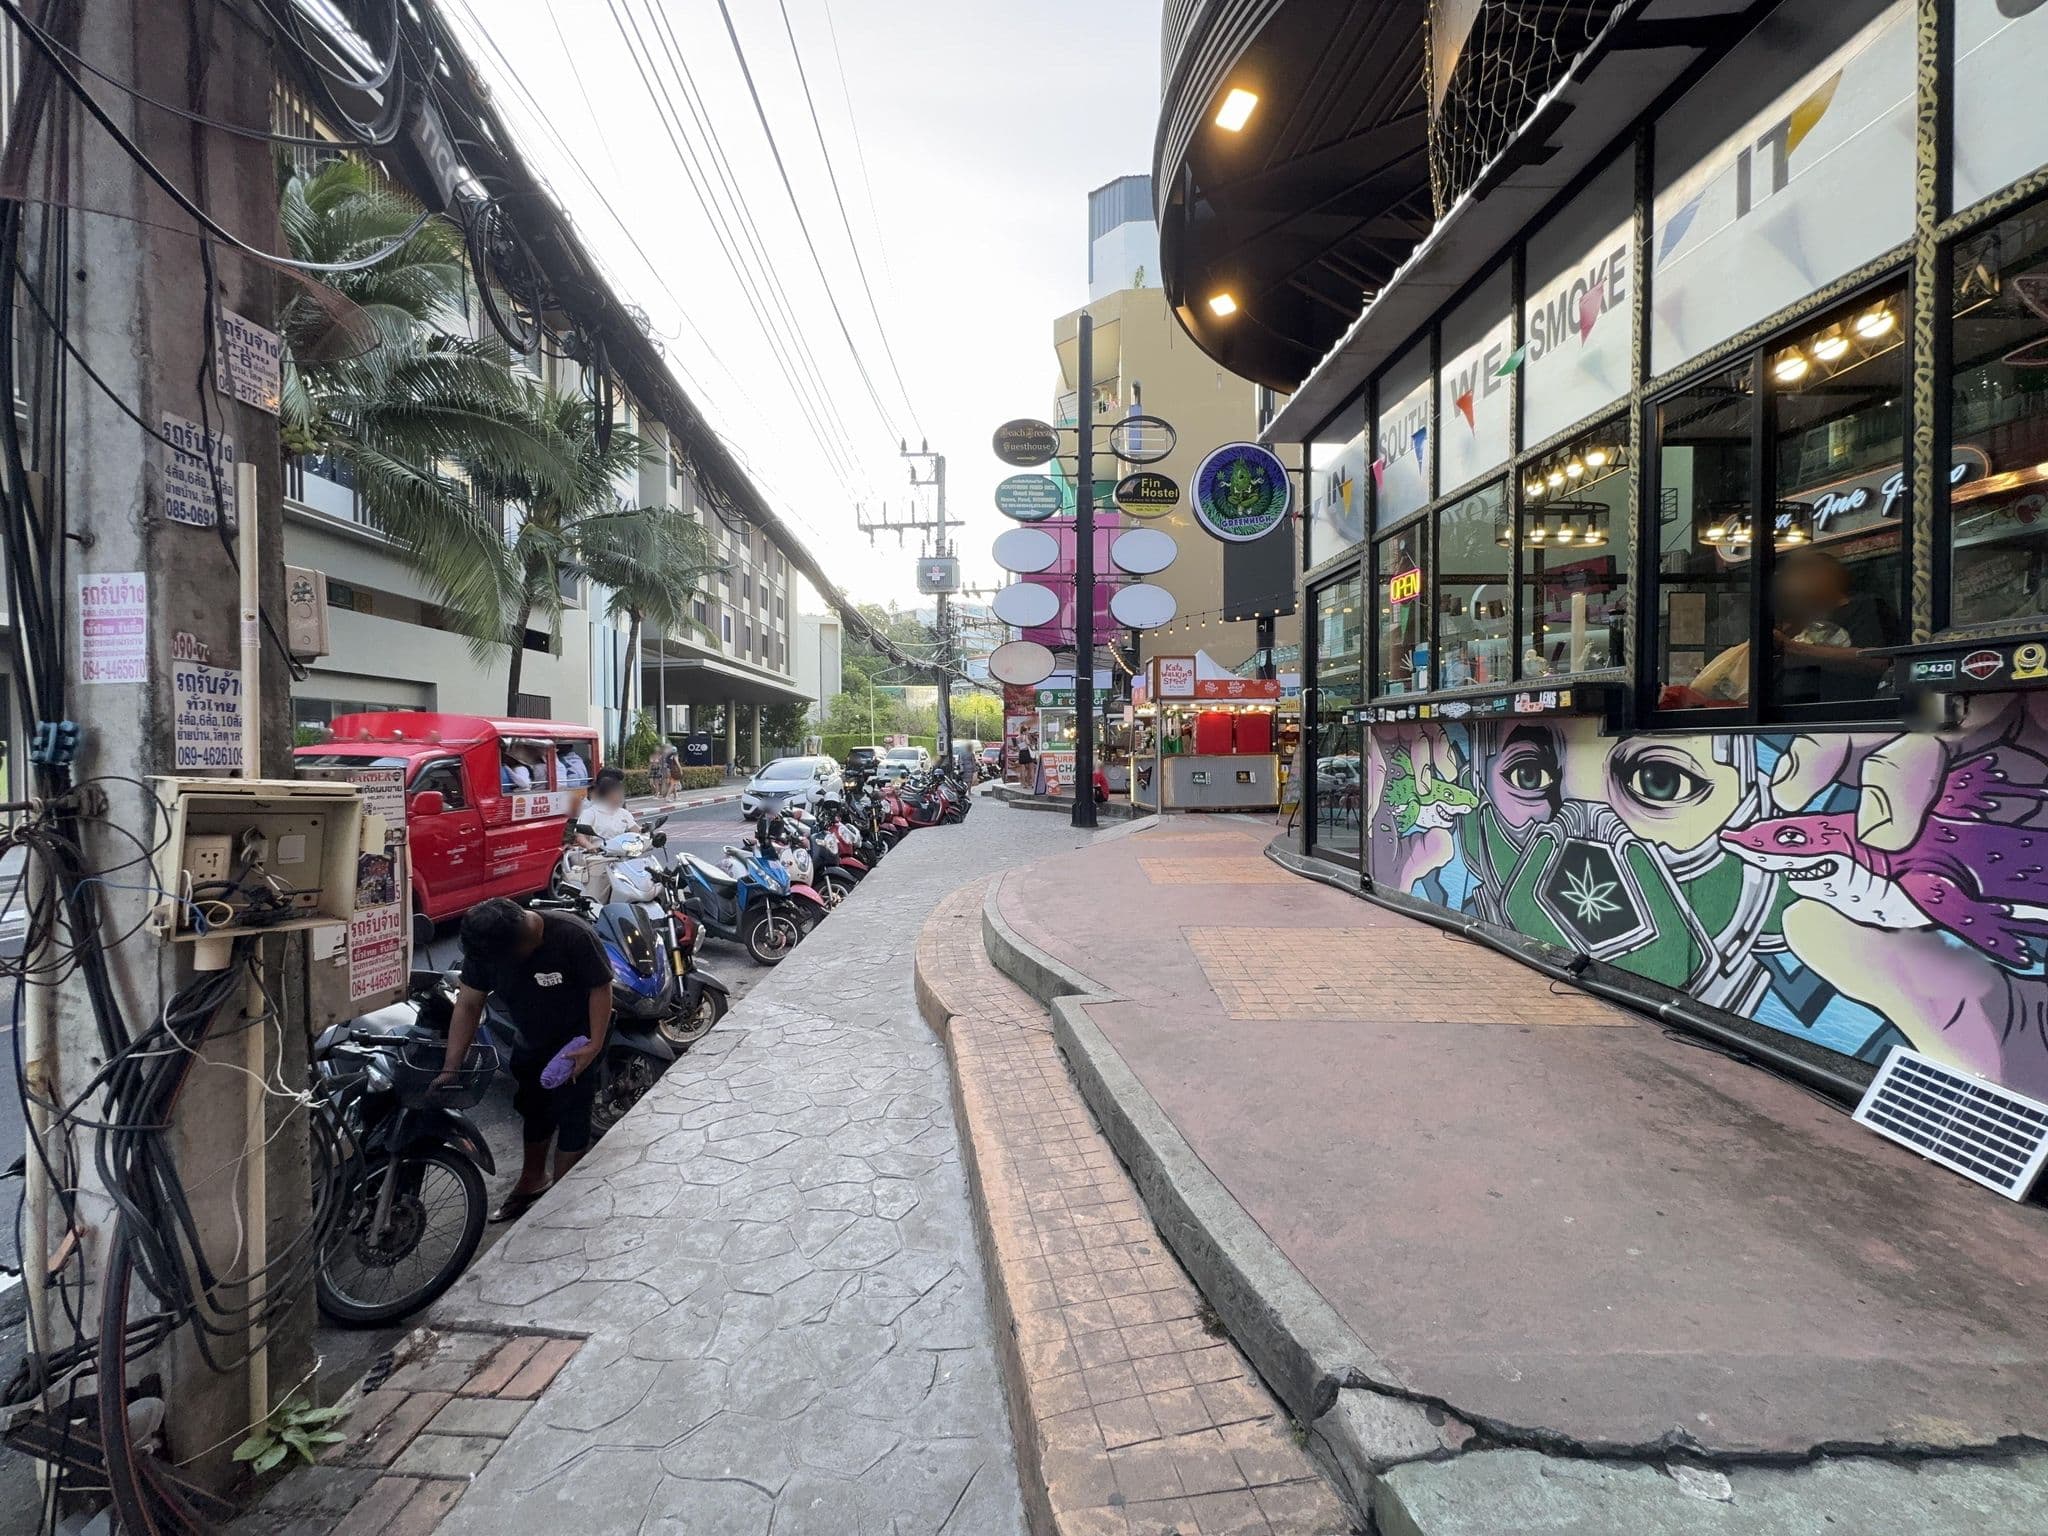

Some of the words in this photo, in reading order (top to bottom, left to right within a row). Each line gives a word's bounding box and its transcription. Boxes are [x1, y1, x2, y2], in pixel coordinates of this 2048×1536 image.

[1328, 463, 1346, 507] IN
[1379, 400, 1428, 469] SOUTH
[1450, 342, 1502, 420] WE
[1530, 243, 1627, 362] SMOKE
[1736, 113, 1792, 221] IT
[1141, 487, 1178, 497] Hostel
[1142, 478, 1160, 487] Fin
[1391, 570, 1420, 602] OPEN
[1929, 664, 1953, 673] 420
[186, 693, 236, 713] ทั่วไทย
[351, 968, 401, 998] 084-4465670
